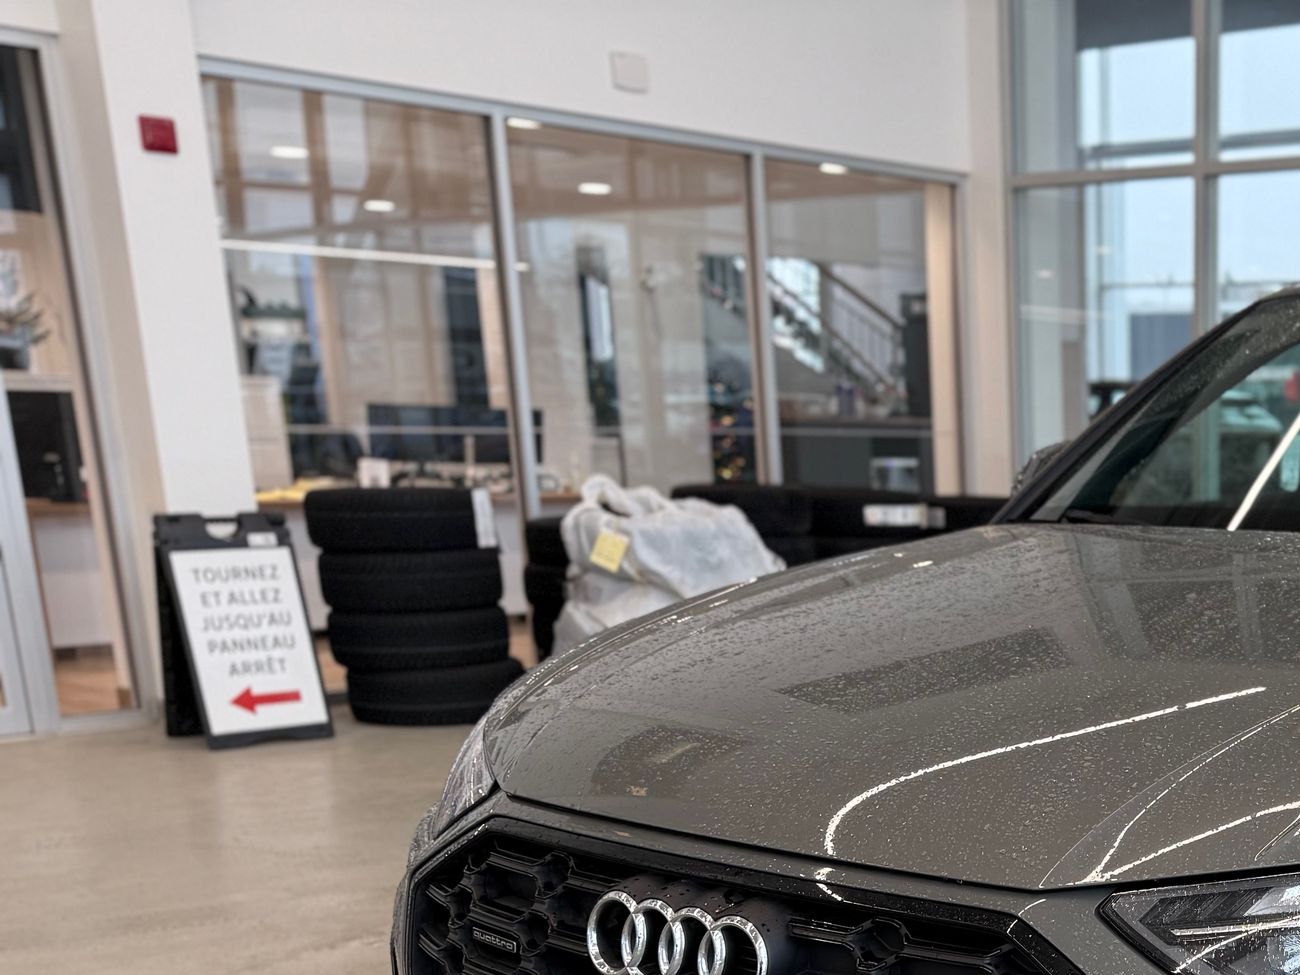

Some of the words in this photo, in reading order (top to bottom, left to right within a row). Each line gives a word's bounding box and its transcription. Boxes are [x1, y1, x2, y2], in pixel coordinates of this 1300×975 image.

[191, 564, 280, 584] TOURNEZ
[200, 590, 220, 608] ET
[228, 588, 281, 607] ALLEZ
[202, 611, 293, 632] JUSQU'AU
[208, 634, 296, 654] PANNEAU
[228, 657, 287, 677] ARRÊT
[472, 930, 513, 950] quattro
